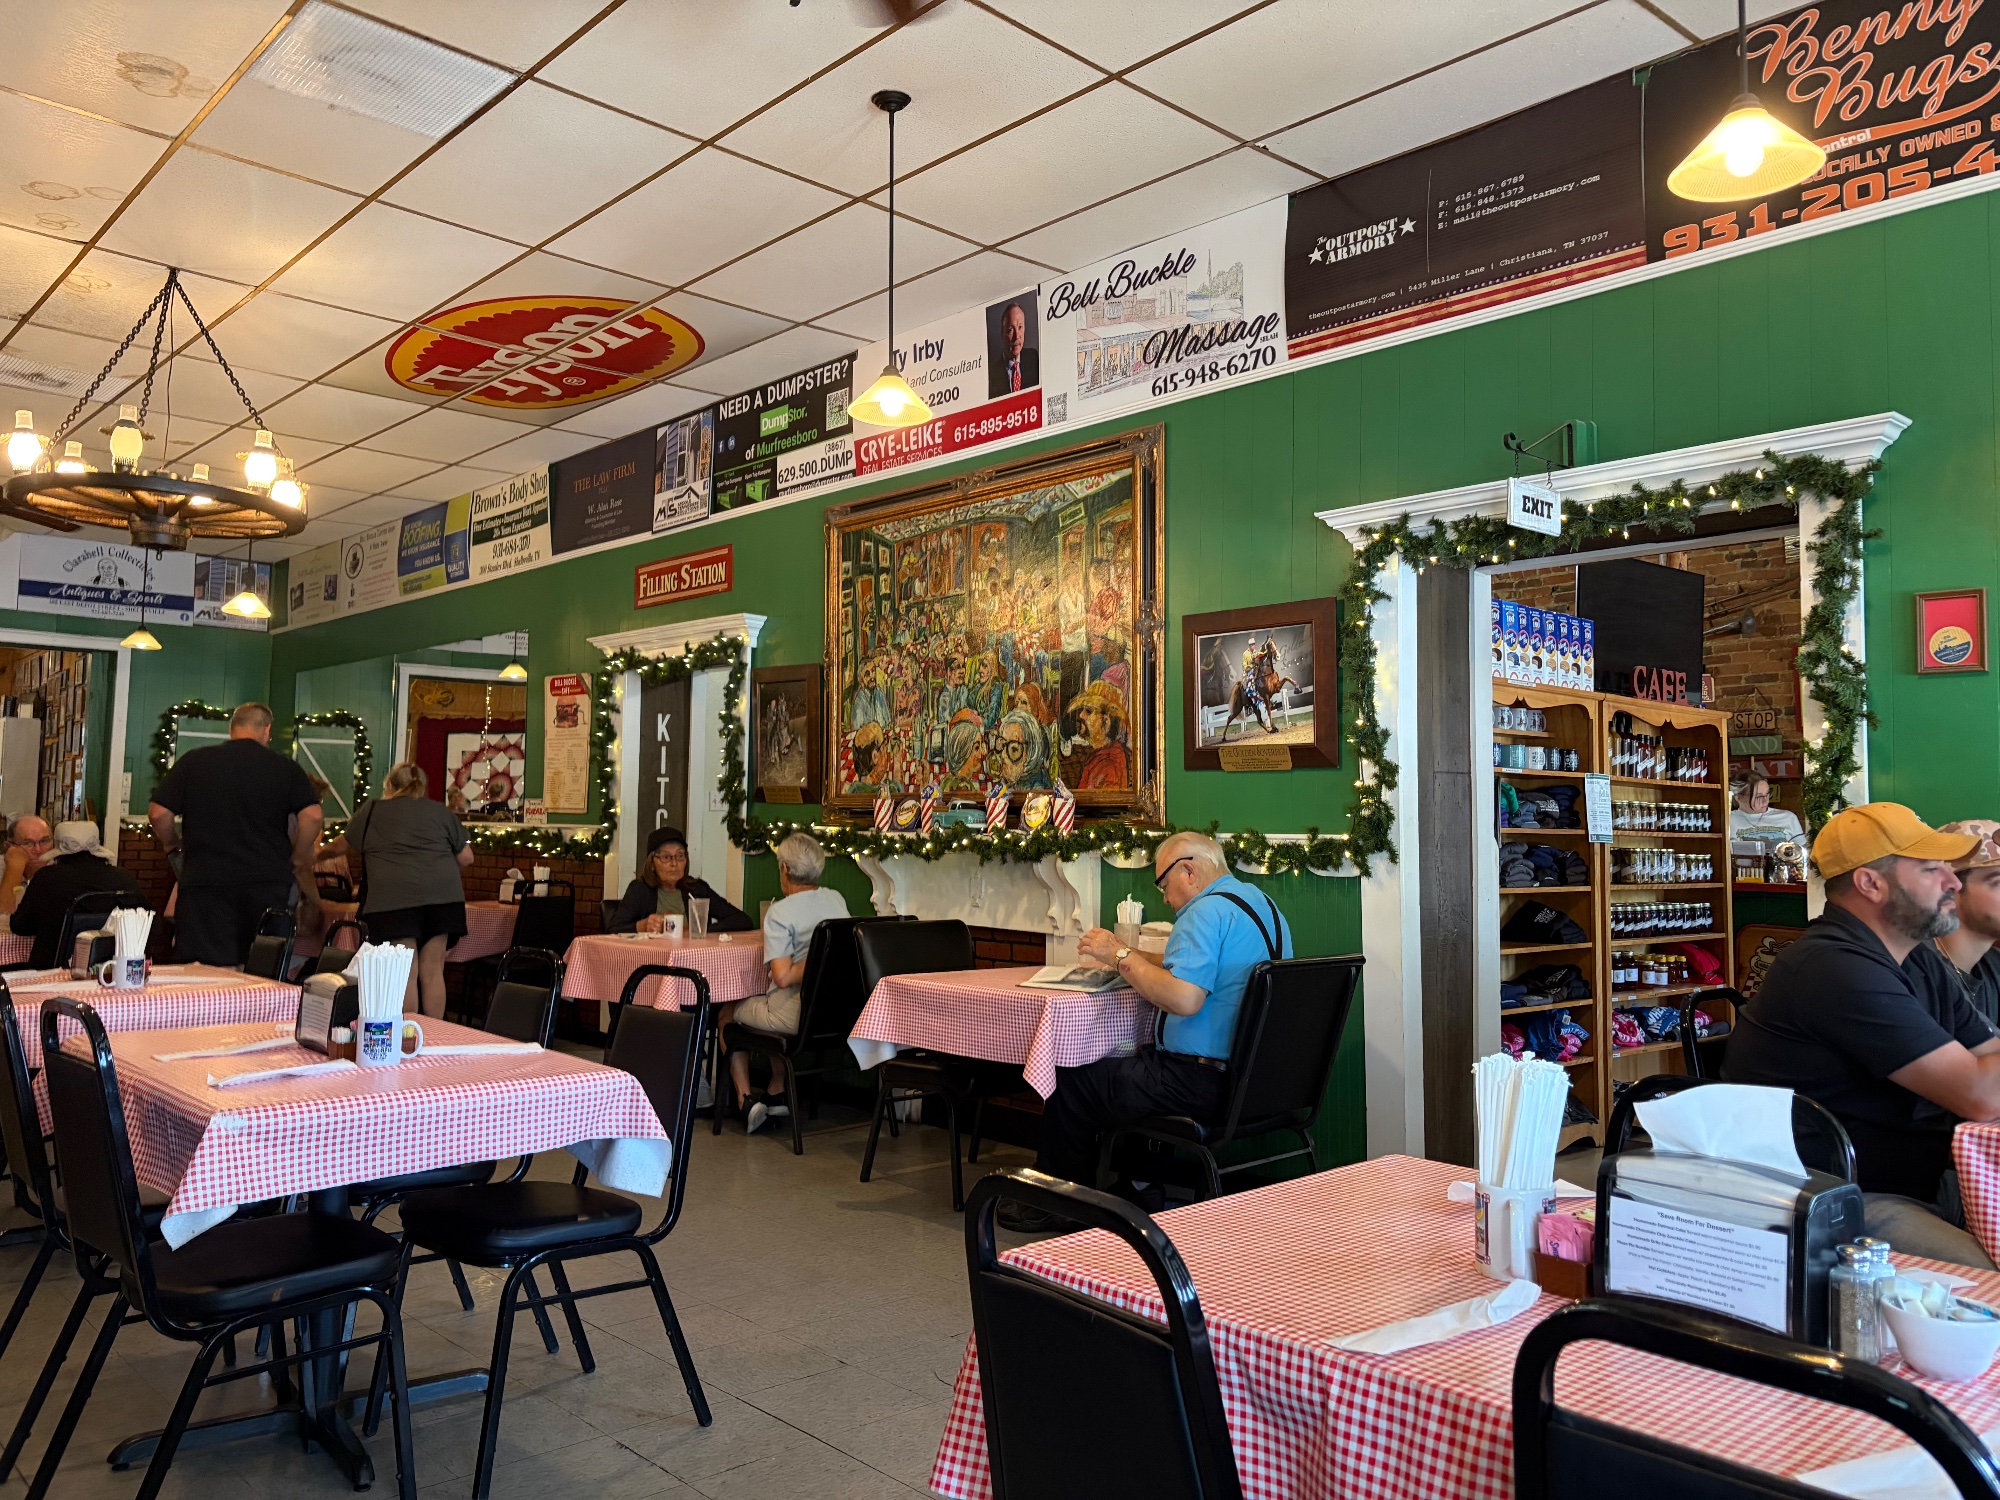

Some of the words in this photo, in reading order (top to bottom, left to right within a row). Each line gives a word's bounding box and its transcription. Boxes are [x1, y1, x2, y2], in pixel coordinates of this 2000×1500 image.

[1786, 41, 1994, 129] Bugs
[1900, 120, 1982, 157] OWNED
[1438, 199, 1450, 208] P:
[1454, 173, 1526, 203] 615.867.6789
[1438, 220, 1449, 230] E:
[1452, 173, 1601, 225] mail@theoutpostarmory.com
[1438, 210, 1449, 219] F:
[1454, 185, 1525, 214] 615.848.1373
[1325, 230, 1398, 265] ARMORY
[1326, 216, 1398, 251] OUTPOST
[1046, 278, 1101, 322] Bell
[1105, 247, 1198, 300] Buckle
[1308, 290, 1396, 320] theoutpostarmory.com
[1430, 271, 1461, 288] Miller
[1464, 266, 1486, 278] Lane
[1499, 246, 1558, 268] Christiana,
[1563, 240, 1575, 250] TN
[1580, 230, 1610, 246] 37037
[407, 312, 655, 398] Tyson
[913, 338, 945, 362] Irby
[1142, 311, 1281, 370] Massage
[929, 354, 983, 383] Consultant
[1152, 345, 1277, 397] 615-948-6270
[719, 395, 751, 422] NEED
[754, 390, 763, 410] A
[767, 358, 849, 405] DUMPSTER?
[745, 444, 755, 461] of
[756, 428, 818, 458] Murfreesboro
[860, 420, 944, 463] CRYE-LEIKE
[954, 405, 1038, 442] 615-895-9518
[574, 476, 591, 493] THE
[593, 469, 611, 488] LAW
[613, 461, 636, 481] FIRM
[777, 449, 853, 485] 629.500.DUMP
[881, 455, 905, 471] ESTATE
[473, 485, 507, 515] Brown's
[508, 478, 529, 505] Body
[529, 472, 548, 496] Shop
[1521, 494, 1553, 519] EXIT
[62, 545, 104, 573] Clarabell
[48, 584, 106, 602] Antiques
[639, 571, 679, 599] FILLING
[680, 561, 727, 590] STATION
[1632, 664, 1689, 706] CAFE
[1735, 711, 1774, 730] STOP
[1735, 736, 1779, 754] AND
[1695, 1220, 1705, 1229] For
